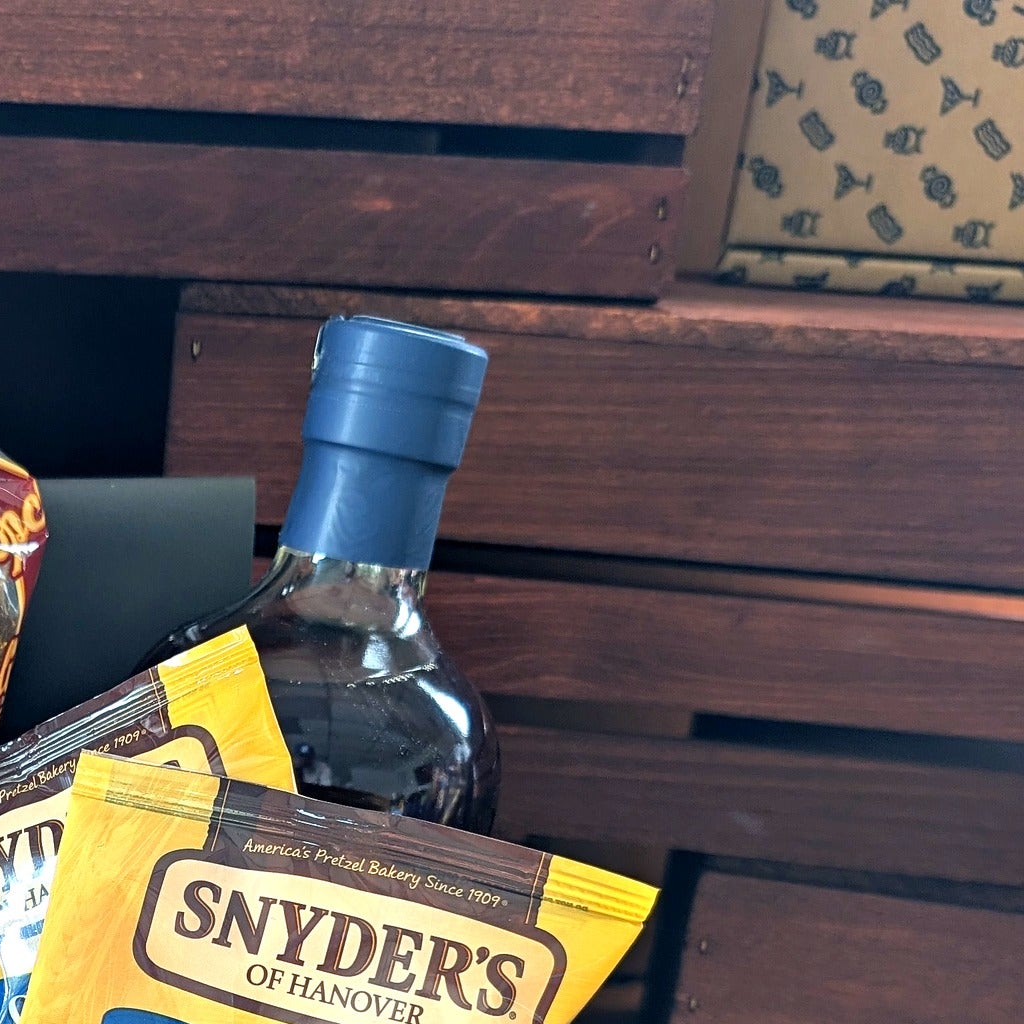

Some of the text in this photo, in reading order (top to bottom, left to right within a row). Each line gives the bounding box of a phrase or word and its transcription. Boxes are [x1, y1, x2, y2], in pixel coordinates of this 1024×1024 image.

[114, 730, 141, 749] 1909
[38, 758, 76, 784] Bakery
[243, 838, 502, 908] America's Pretzel Bakery Since 1909
[173, 879, 527, 1018] SNYDER'S
[246, 963, 285, 991] OF
